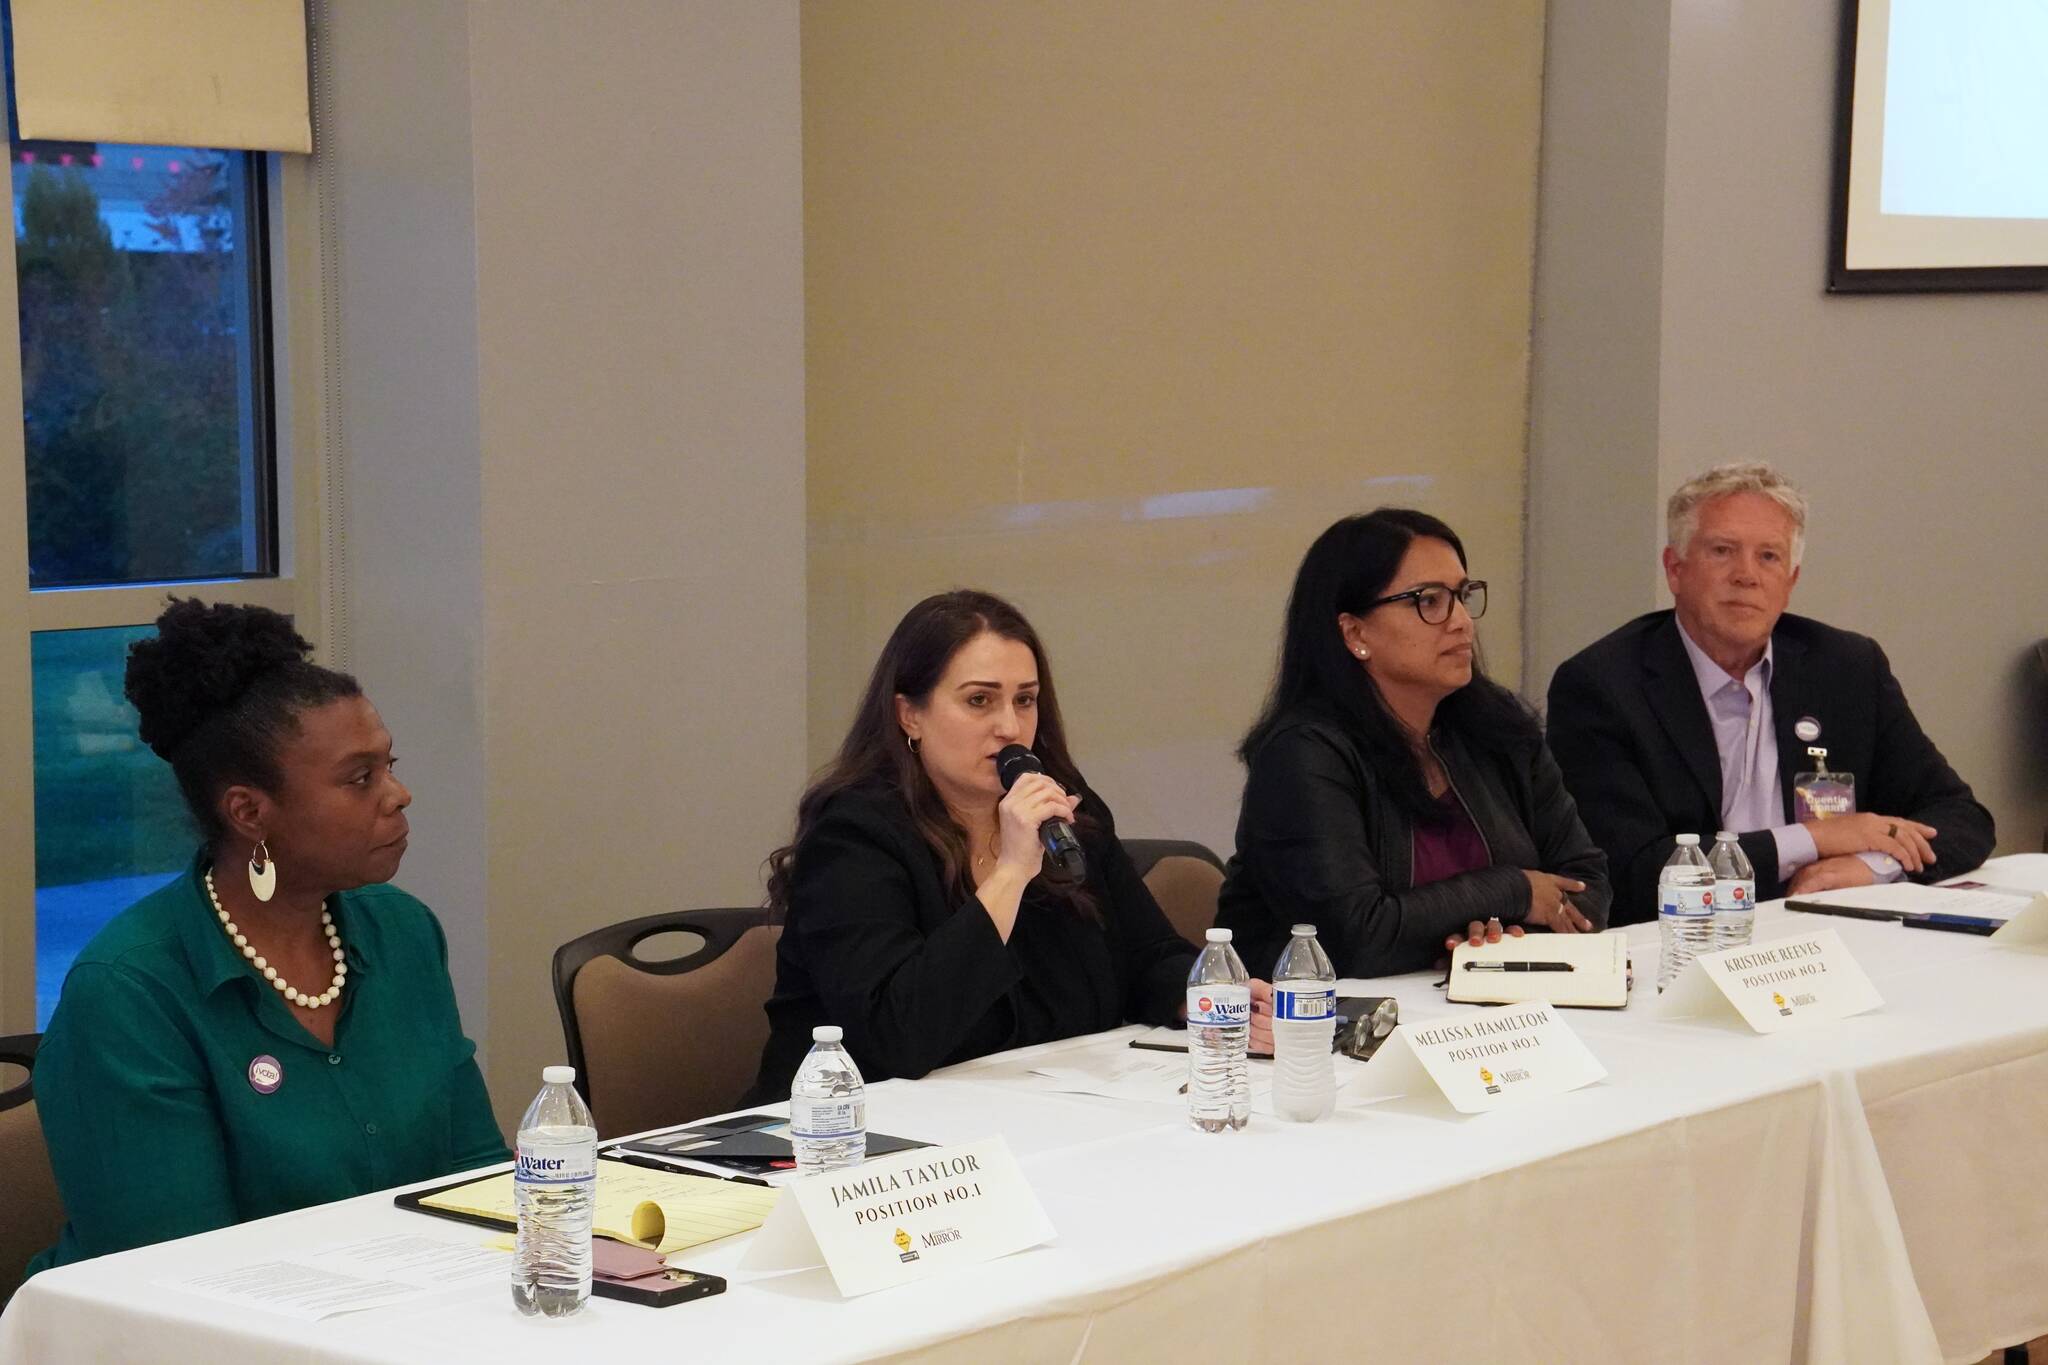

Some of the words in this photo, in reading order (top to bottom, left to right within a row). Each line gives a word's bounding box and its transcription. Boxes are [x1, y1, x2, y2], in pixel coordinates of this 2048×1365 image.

[1724, 951, 1780, 973] KRISTINE
[1778, 940, 1822, 962] REEVES
[1742, 968, 1798, 989] POSITION
[1215, 1003, 1249, 1014] Water
[1414, 1027, 1472, 1047] MELISSA
[1473, 1011, 1549, 1037] HAMILTON
[1448, 1041, 1508, 1063] POSITION
[520, 1155, 564, 1170] Water
[831, 1174, 902, 1208] JAMILA
[902, 1154, 980, 1187] TAYLOR
[855, 1193, 938, 1225] POSITION
